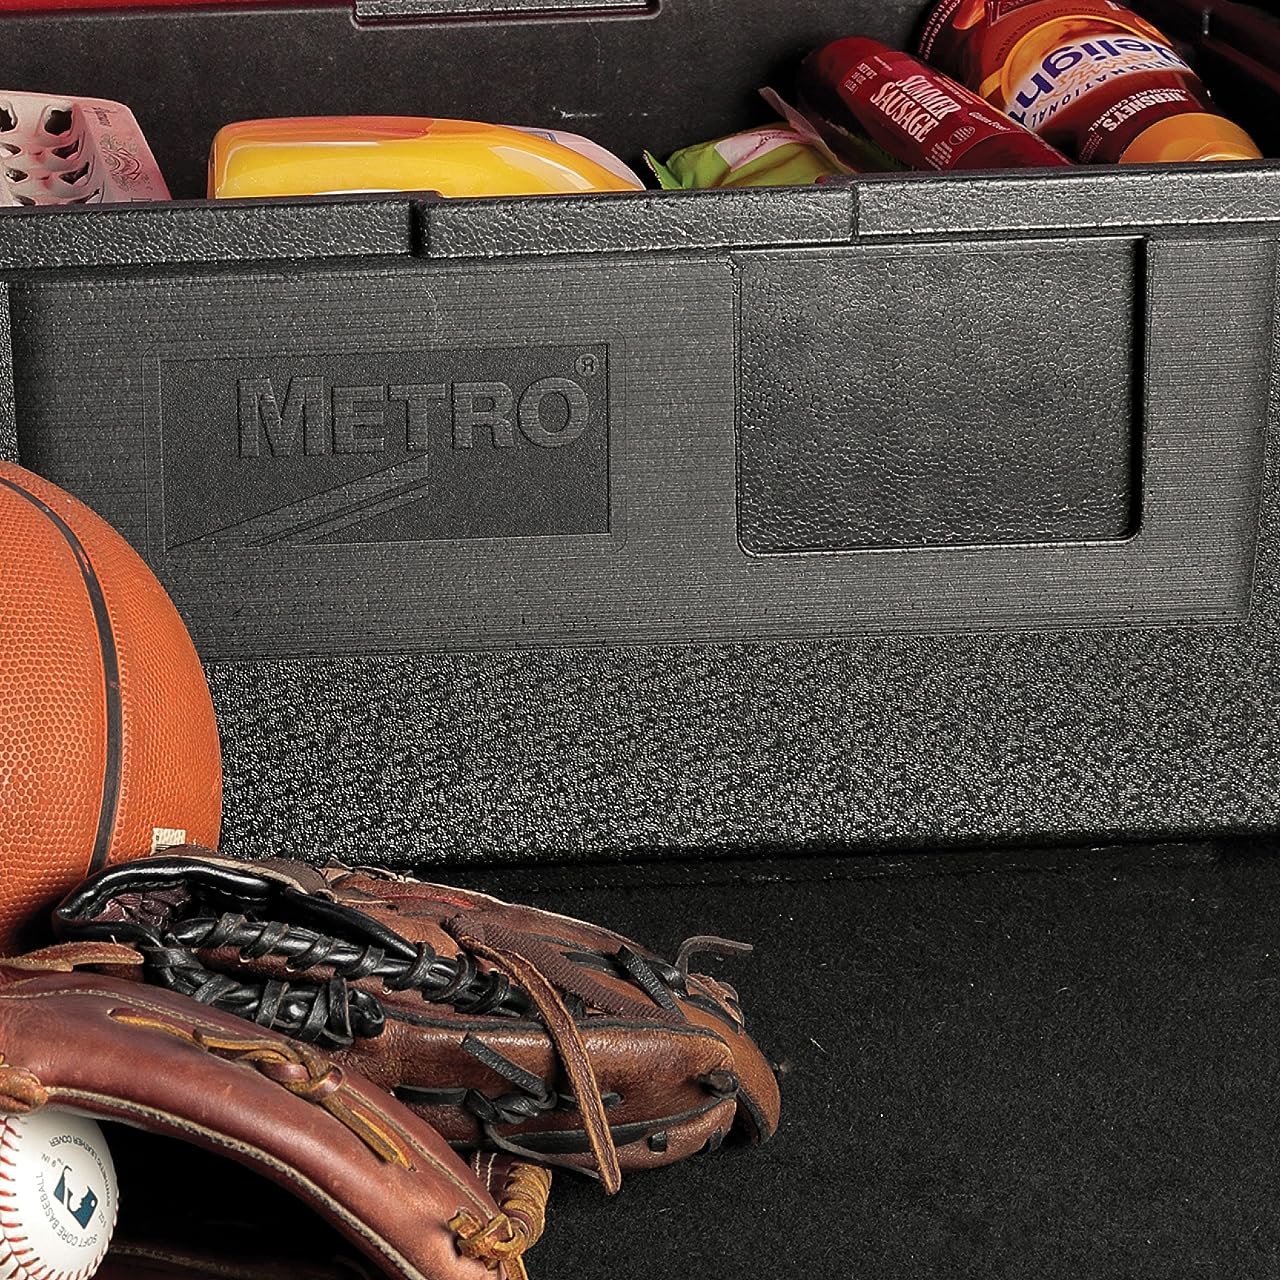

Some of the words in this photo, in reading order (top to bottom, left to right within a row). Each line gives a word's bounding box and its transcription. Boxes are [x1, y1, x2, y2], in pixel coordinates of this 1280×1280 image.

[870, 82, 939, 142] SAUSAGE
[896, 75, 961, 120] SUMMER
[1088, 97, 1131, 132] CARAMEL
[1108, 90, 1188, 133] HERSHEY'S
[237, 376, 590, 459] METRO
[48, 1134, 72, 1147] COVER
[36, 1171, 60, 1230] BASEBALL
[56, 1225, 78, 1246] CORE
[77, 1233, 99, 1248] SOFT
